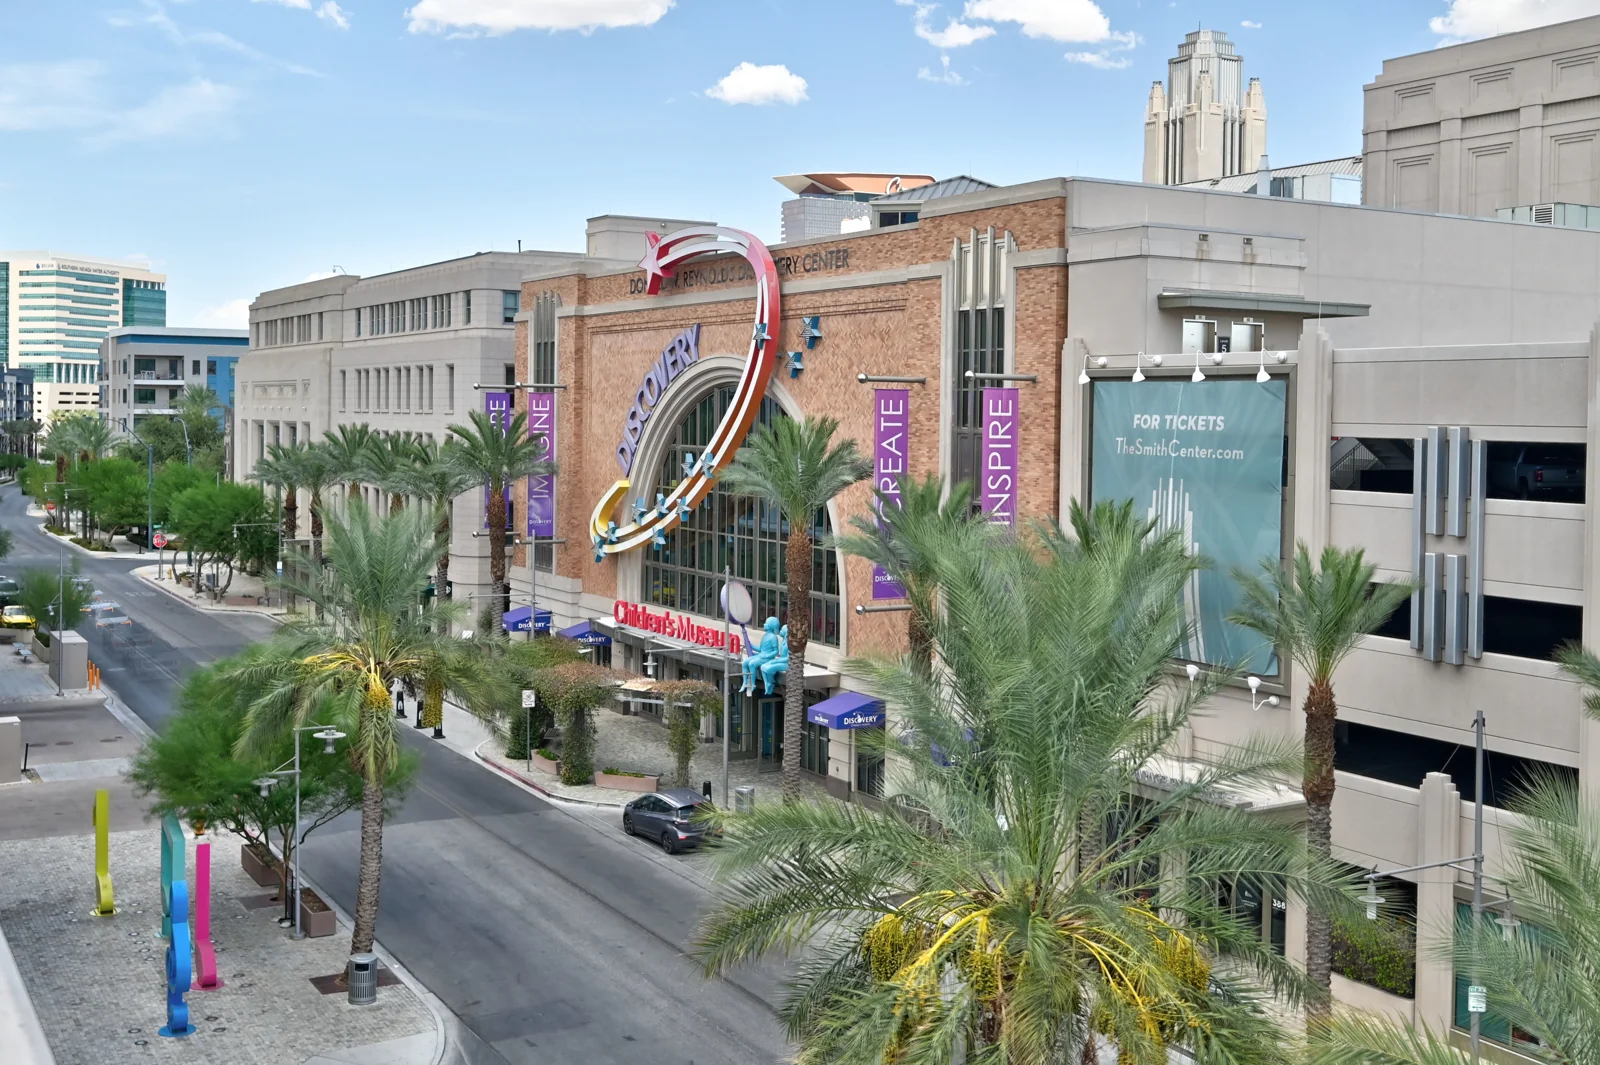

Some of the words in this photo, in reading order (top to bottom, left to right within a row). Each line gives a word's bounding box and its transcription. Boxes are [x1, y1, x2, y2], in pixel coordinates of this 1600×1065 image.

[683, 267, 734, 287] REYNOLDS
[802, 248, 850, 273] CENTER
[616, 323, 701, 478] DISCOVERY
[1133, 414, 1160, 429] FOR
[1165, 415, 1225, 431] TICKETS
[532, 399, 550, 498] IMGINE
[987, 399, 1013, 526] INSPIRE
[1116, 437, 1244, 460] TheSmithCenter.com
[613, 600, 676, 637] Children's
[676, 615, 741, 655] Museum
[844, 715, 878, 724] DISCOVERY
